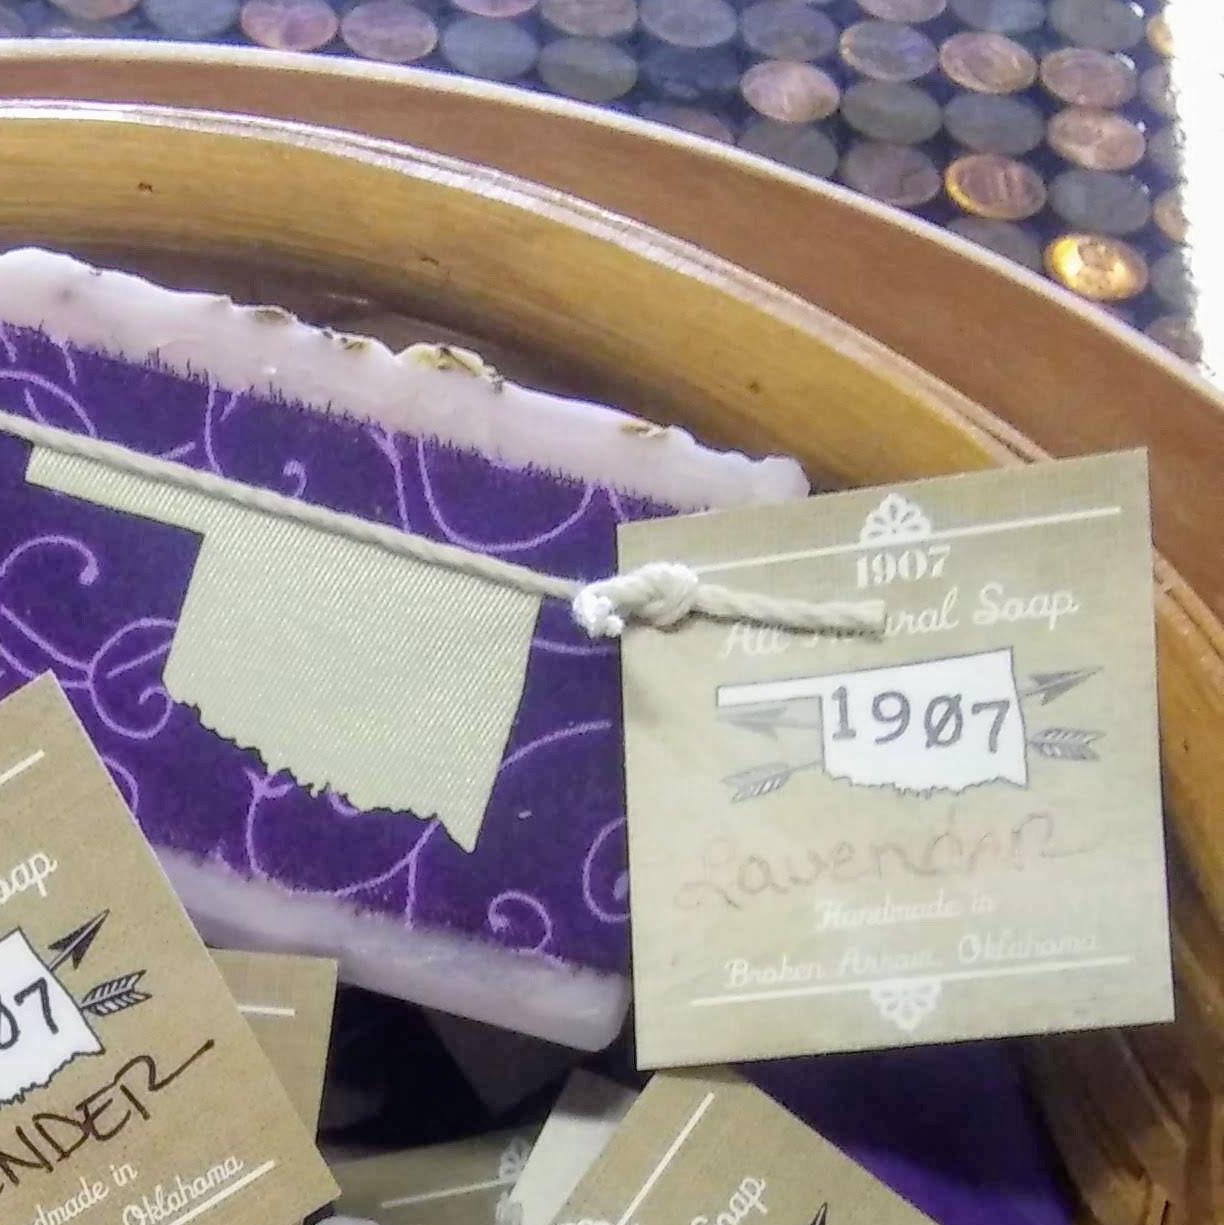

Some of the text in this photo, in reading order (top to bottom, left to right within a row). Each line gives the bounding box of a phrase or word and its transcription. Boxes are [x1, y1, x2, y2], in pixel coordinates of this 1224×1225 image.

[855, 544, 952, 590] 1907
[971, 581, 1080, 631] Soap
[831, 684, 1011, 754] 1907
[815, 888, 997, 932] Handmade in
[723, 953, 825, 990] Broken
[957, 928, 1099, 964] Oklahoma
[109, 1161, 138, 1188] in
